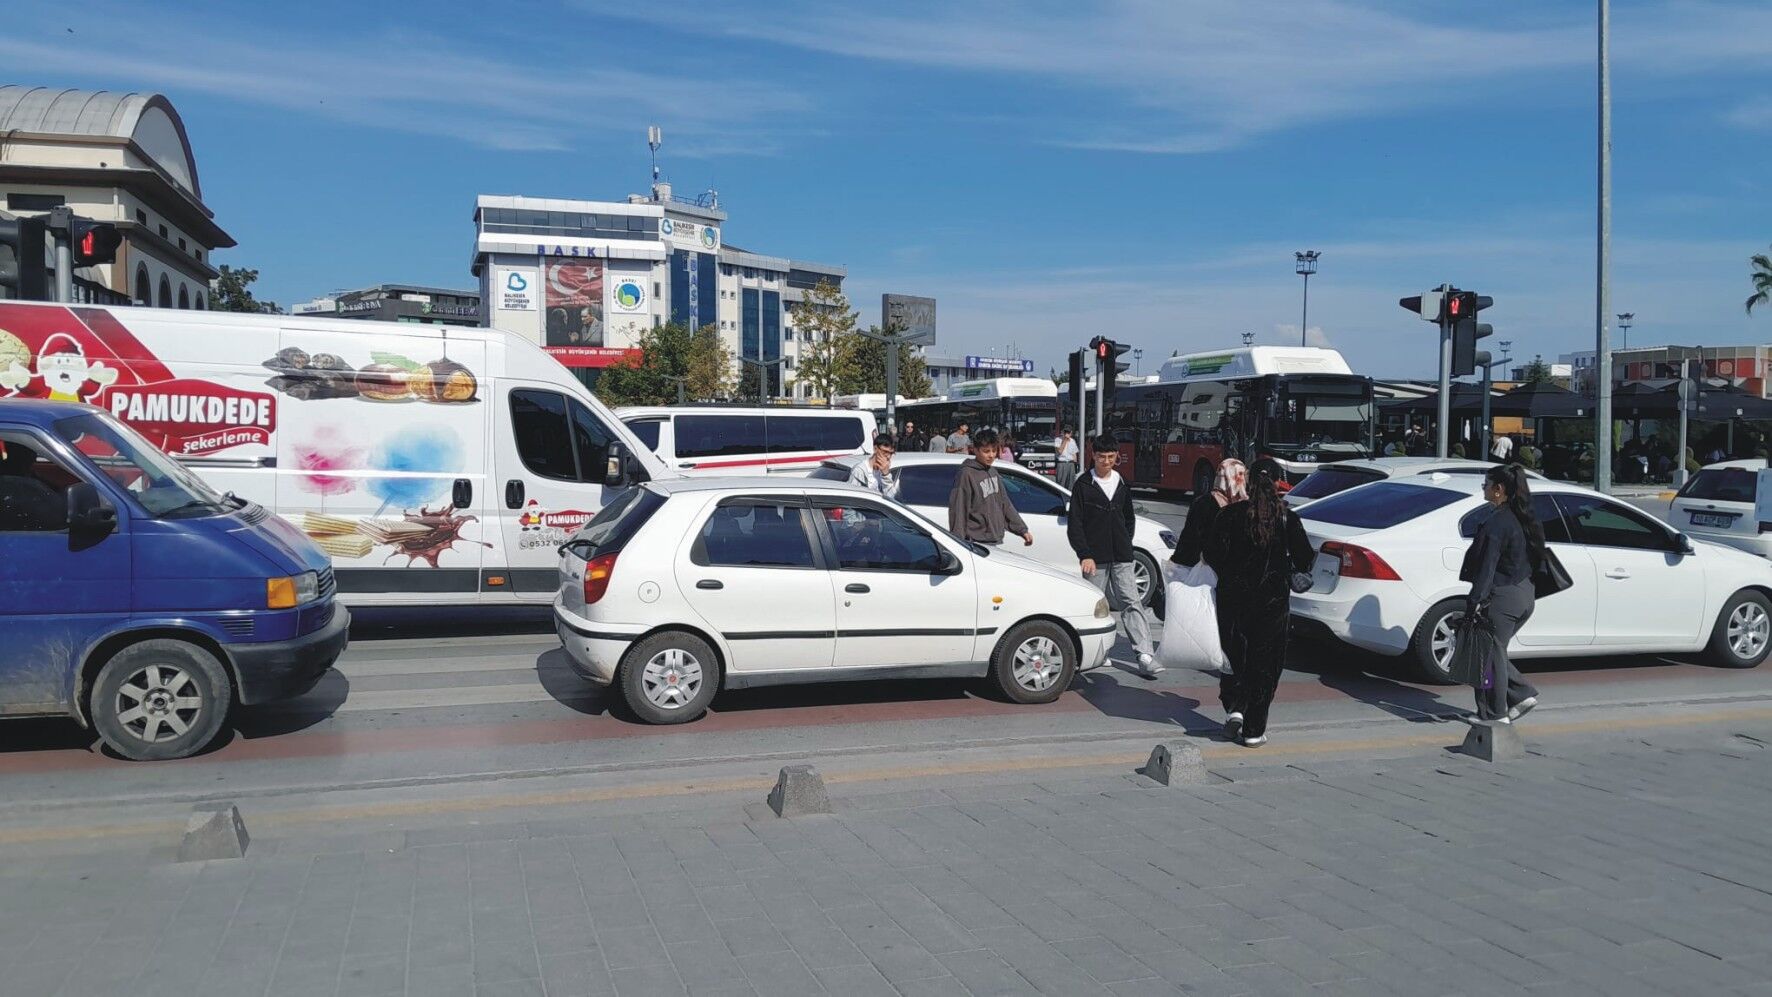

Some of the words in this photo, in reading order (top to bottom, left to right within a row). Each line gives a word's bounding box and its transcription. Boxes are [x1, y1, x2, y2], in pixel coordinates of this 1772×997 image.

[111, 392, 271, 426] PAMUKDEDE
[182, 431, 262, 454] şekerleme
[529, 539, 551, 548] 0532
